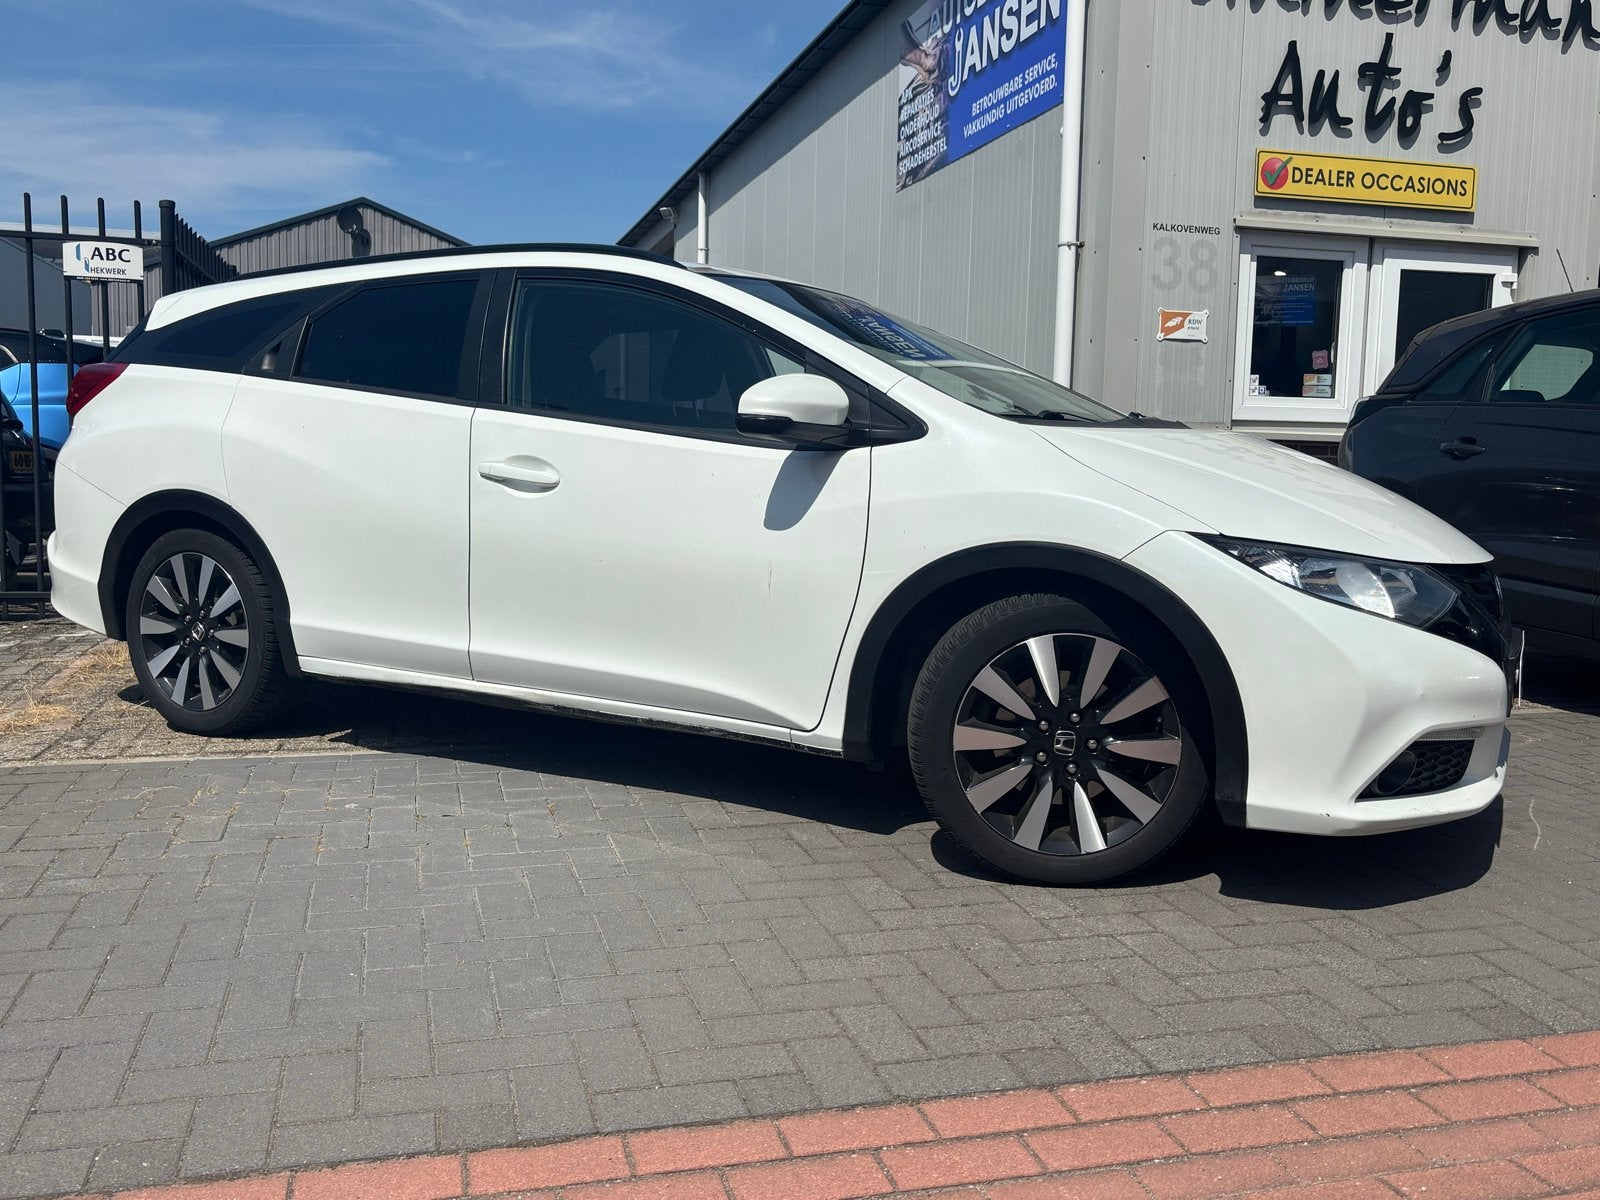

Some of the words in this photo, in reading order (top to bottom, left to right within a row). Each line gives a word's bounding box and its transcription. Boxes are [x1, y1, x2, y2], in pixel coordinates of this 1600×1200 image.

[948, 0, 1060, 96] JANSEN
[900, 86, 913, 105] APK
[972, 73, 1023, 117] BETROUWBARE
[1024, 52, 1059, 85] SERVICE,
[1259, 32, 1483, 145] Auto's
[900, 88, 935, 121] REPARATIES
[900, 104, 940, 139] ONDERHOUD
[963, 104, 1005, 138] VAKKUNDIG
[1006, 74, 1058, 114] UITGEVOERD.
[899, 121, 942, 158] AIRCOSERVICE
[899, 137, 948, 175] SCHADEHERSTEL
[1291, 166, 1355, 189] DEALER
[1361, 171, 1468, 197] OCCASIONS
[1152, 222, 1221, 236] KALKOVENWEG
[90, 246, 131, 263] ABC
[90, 266, 127, 276] HEKWERK
[1152, 236, 1218, 294] 38
